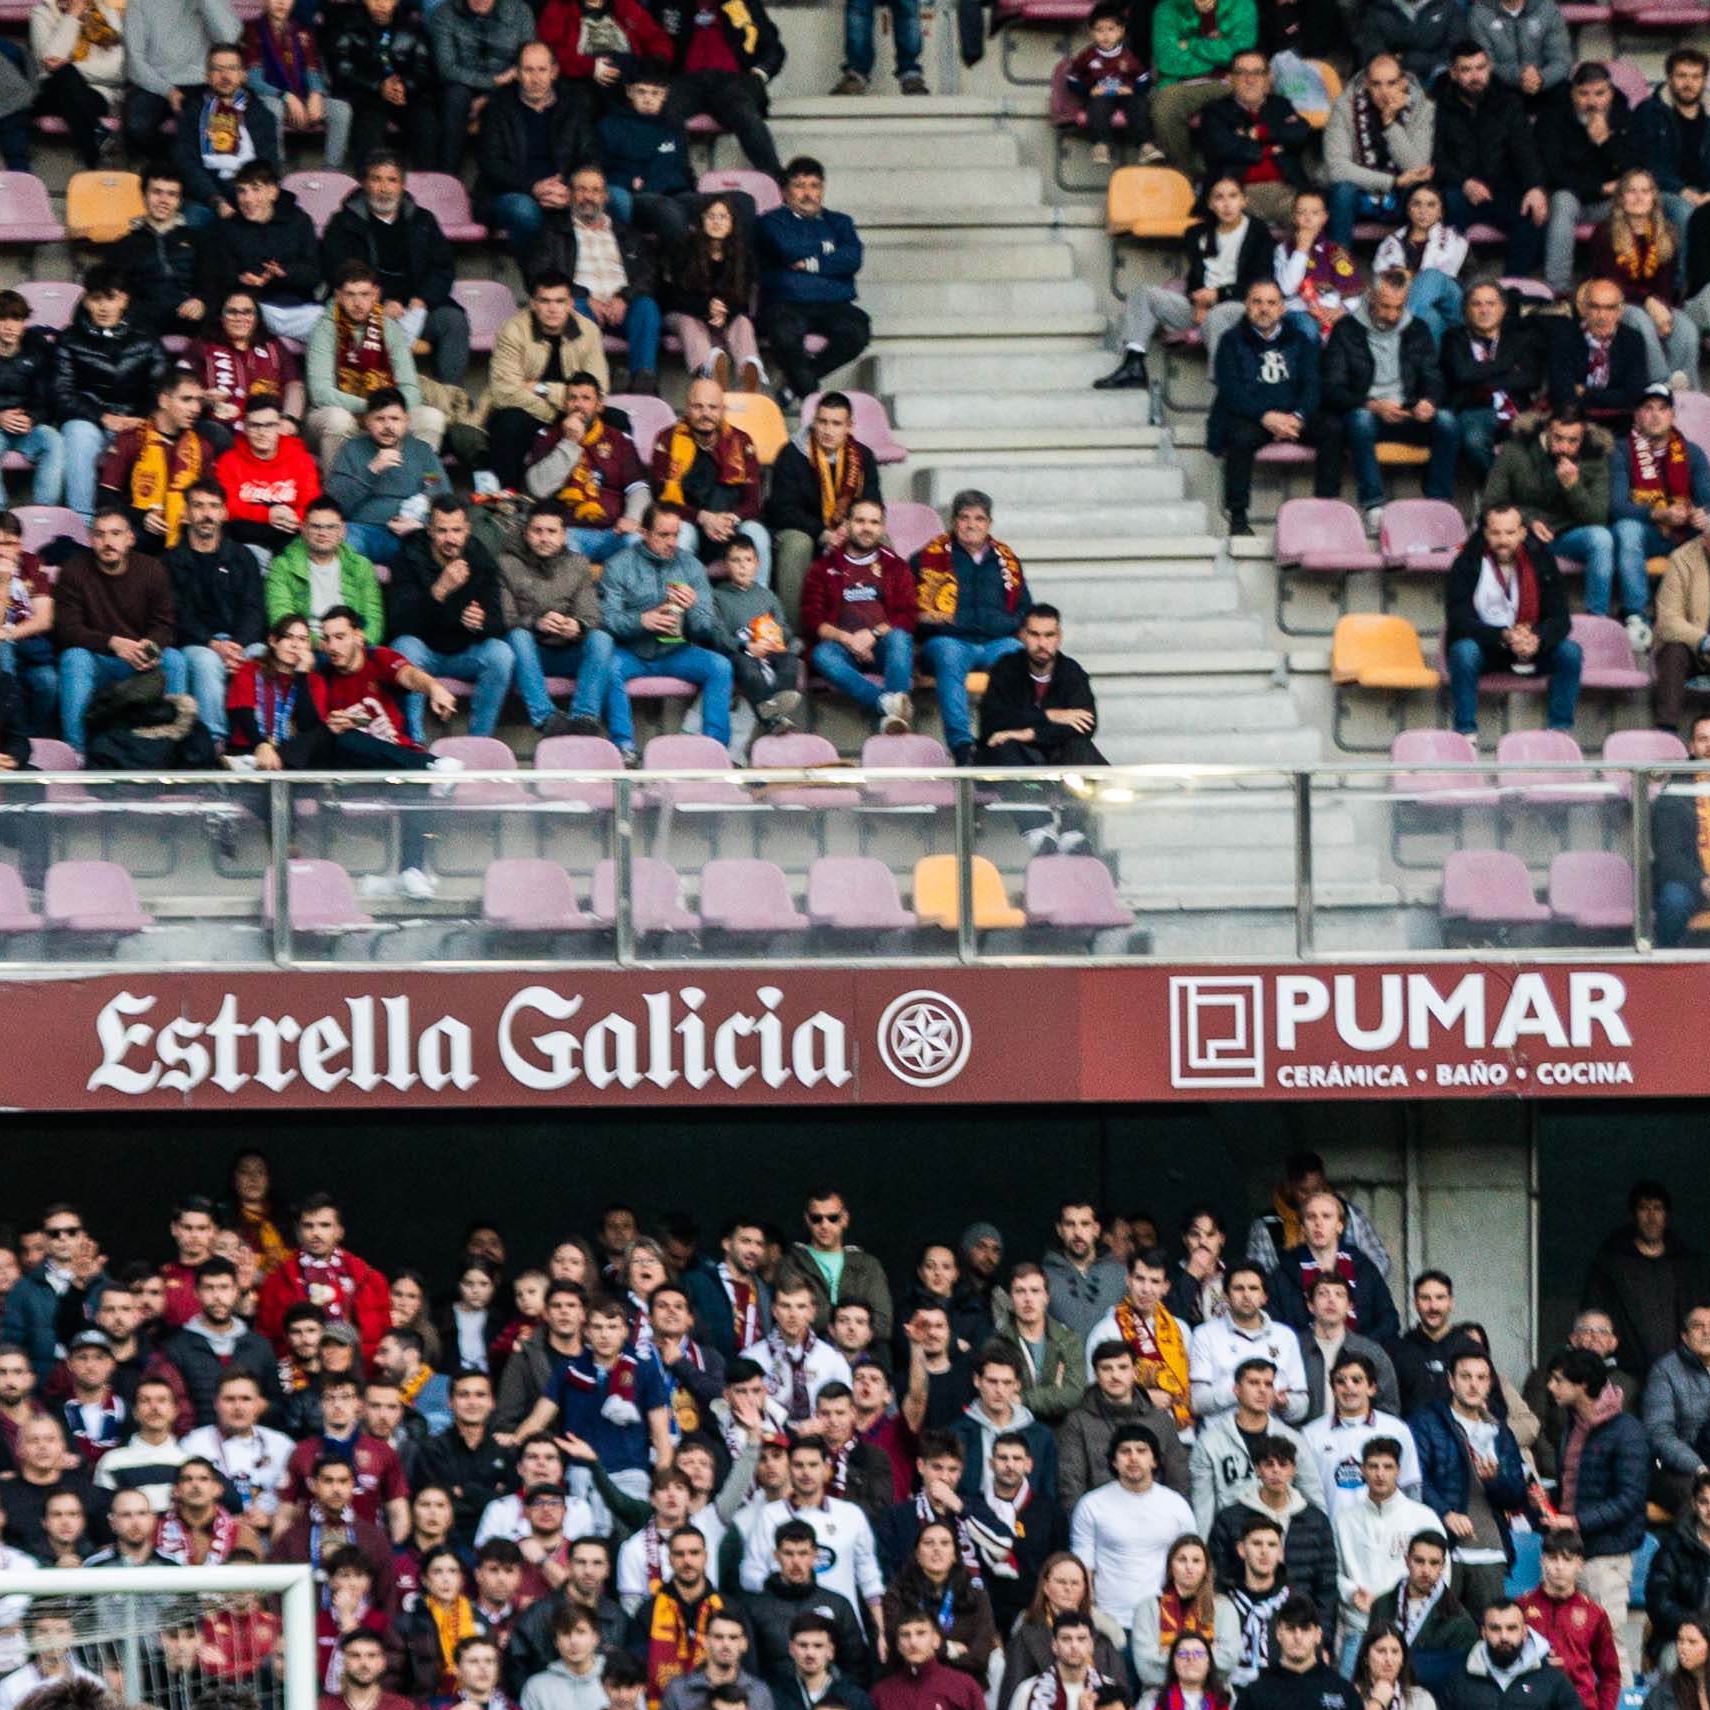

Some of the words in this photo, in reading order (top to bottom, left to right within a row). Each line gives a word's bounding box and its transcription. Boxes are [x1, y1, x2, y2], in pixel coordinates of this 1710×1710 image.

[87, 990, 481, 1094] Estrella
[497, 985, 853, 1092] Galicia
[1275, 971, 1634, 1052] PUMAR
[1277, 1060, 1409, 1088] CERÁMICA
[1436, 1059, 1508, 1087] BAÑO
[1537, 1061, 1634, 1086] COCINA
